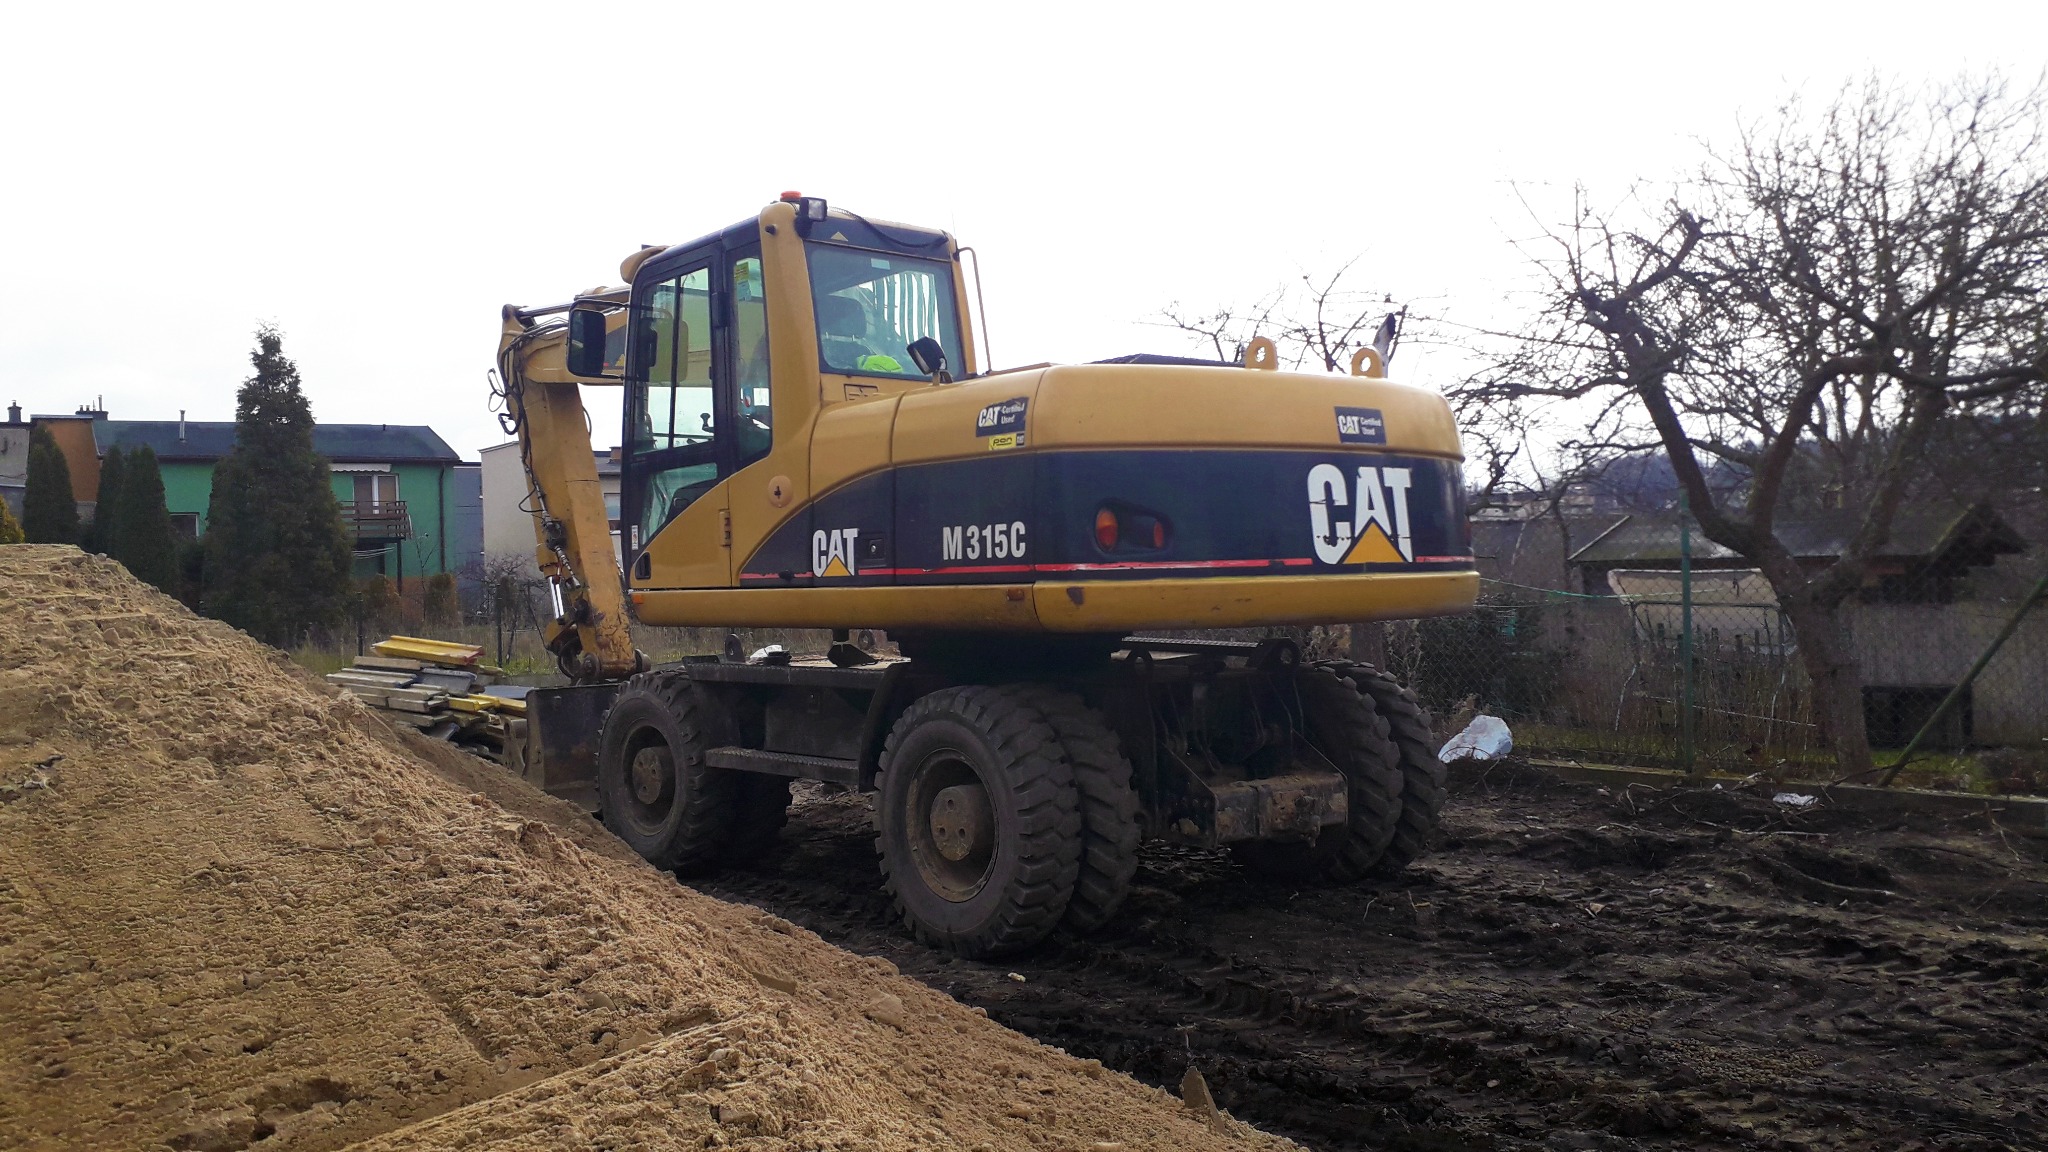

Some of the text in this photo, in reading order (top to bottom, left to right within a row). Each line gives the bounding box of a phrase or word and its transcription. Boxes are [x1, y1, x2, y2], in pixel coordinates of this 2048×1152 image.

[978, 406, 1001, 427] CAT
[1338, 415, 1360, 434] CAT
[1307, 463, 1413, 565] CAT
[812, 528, 858, 577] CAT
[943, 521, 1026, 560] M315C
